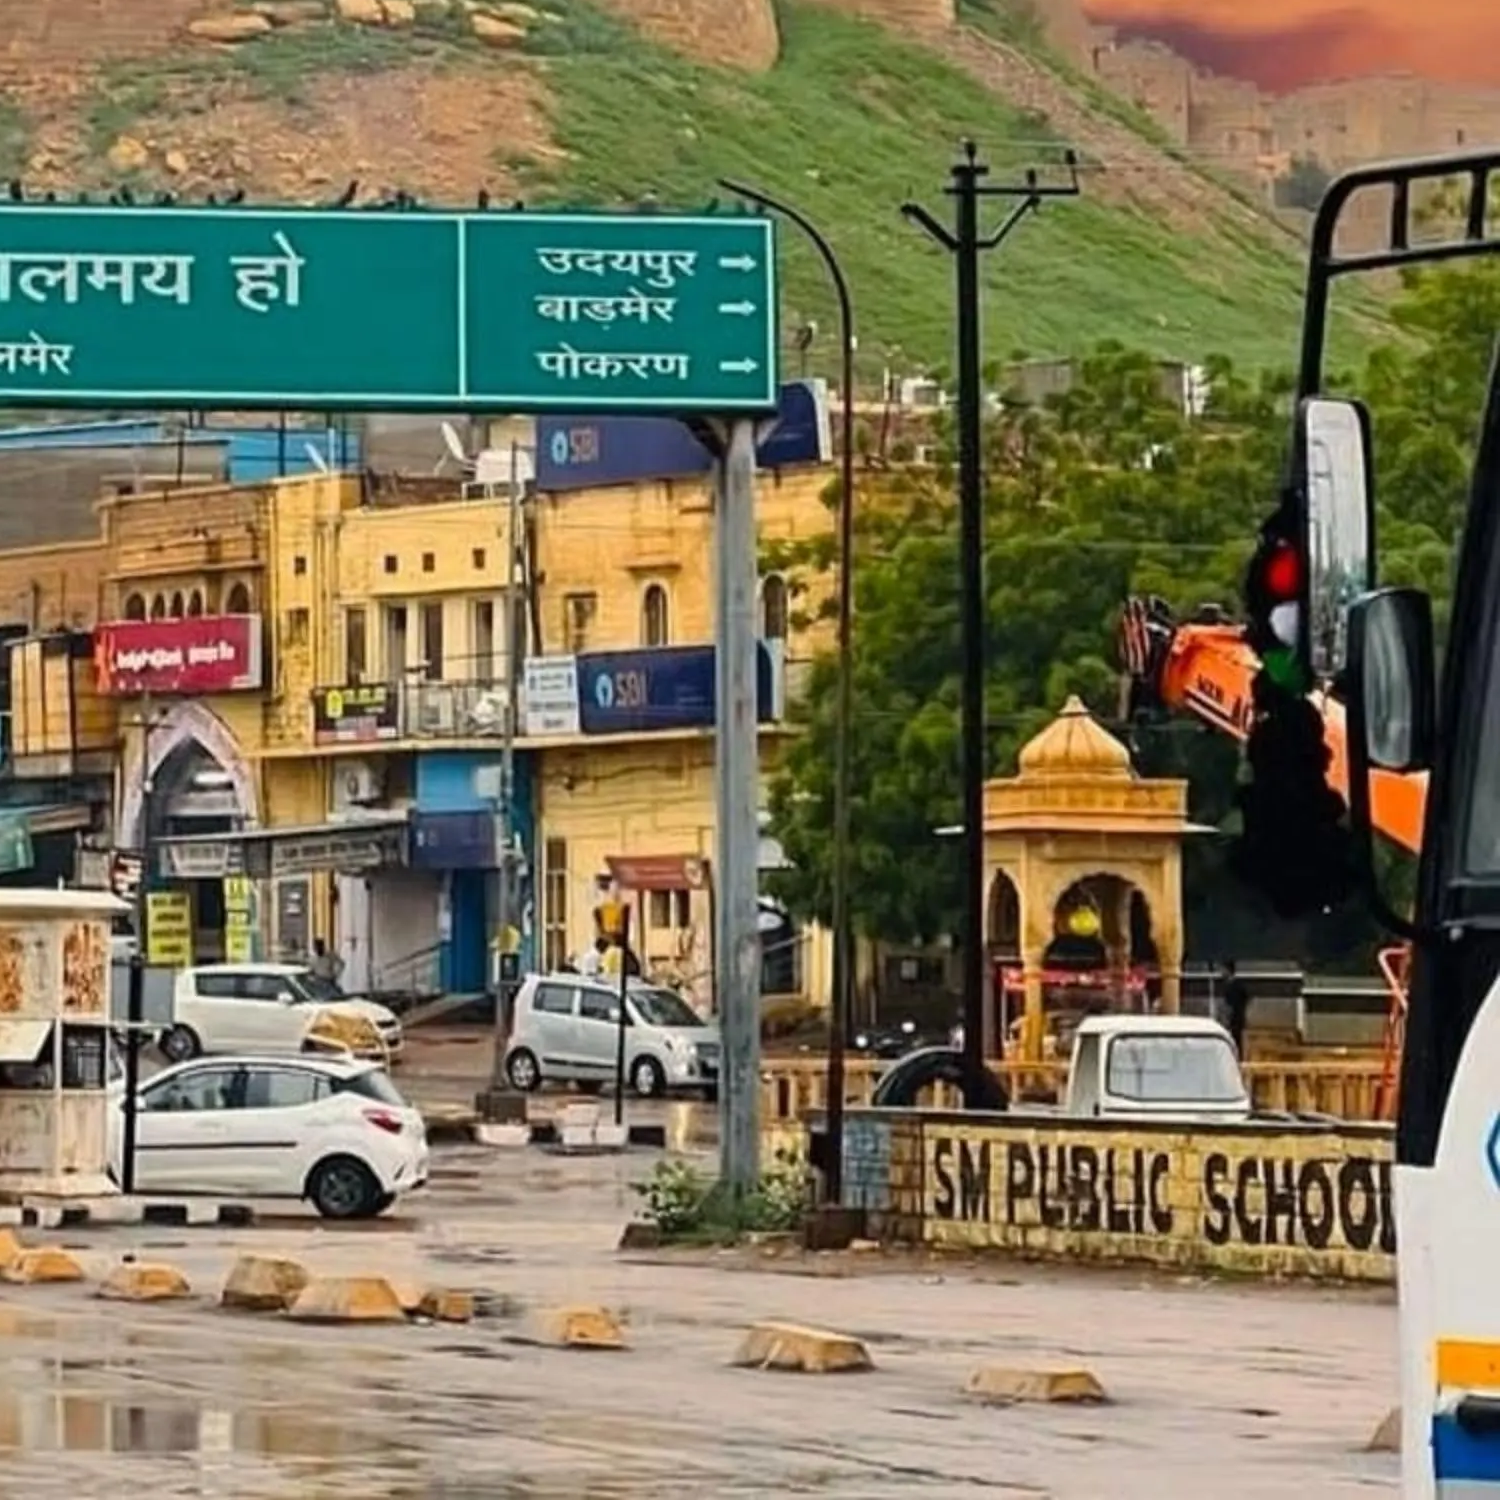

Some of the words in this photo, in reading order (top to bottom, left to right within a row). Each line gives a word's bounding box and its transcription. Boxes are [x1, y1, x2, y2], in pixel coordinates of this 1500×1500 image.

[230, 232, 306, 312] हो
[536, 247, 697, 288] उदयपुर
[536, 342, 689, 380] पोकरण
[933, 1137, 992, 1223] SM
[1006, 1141, 1175, 1234] PUBLIC
